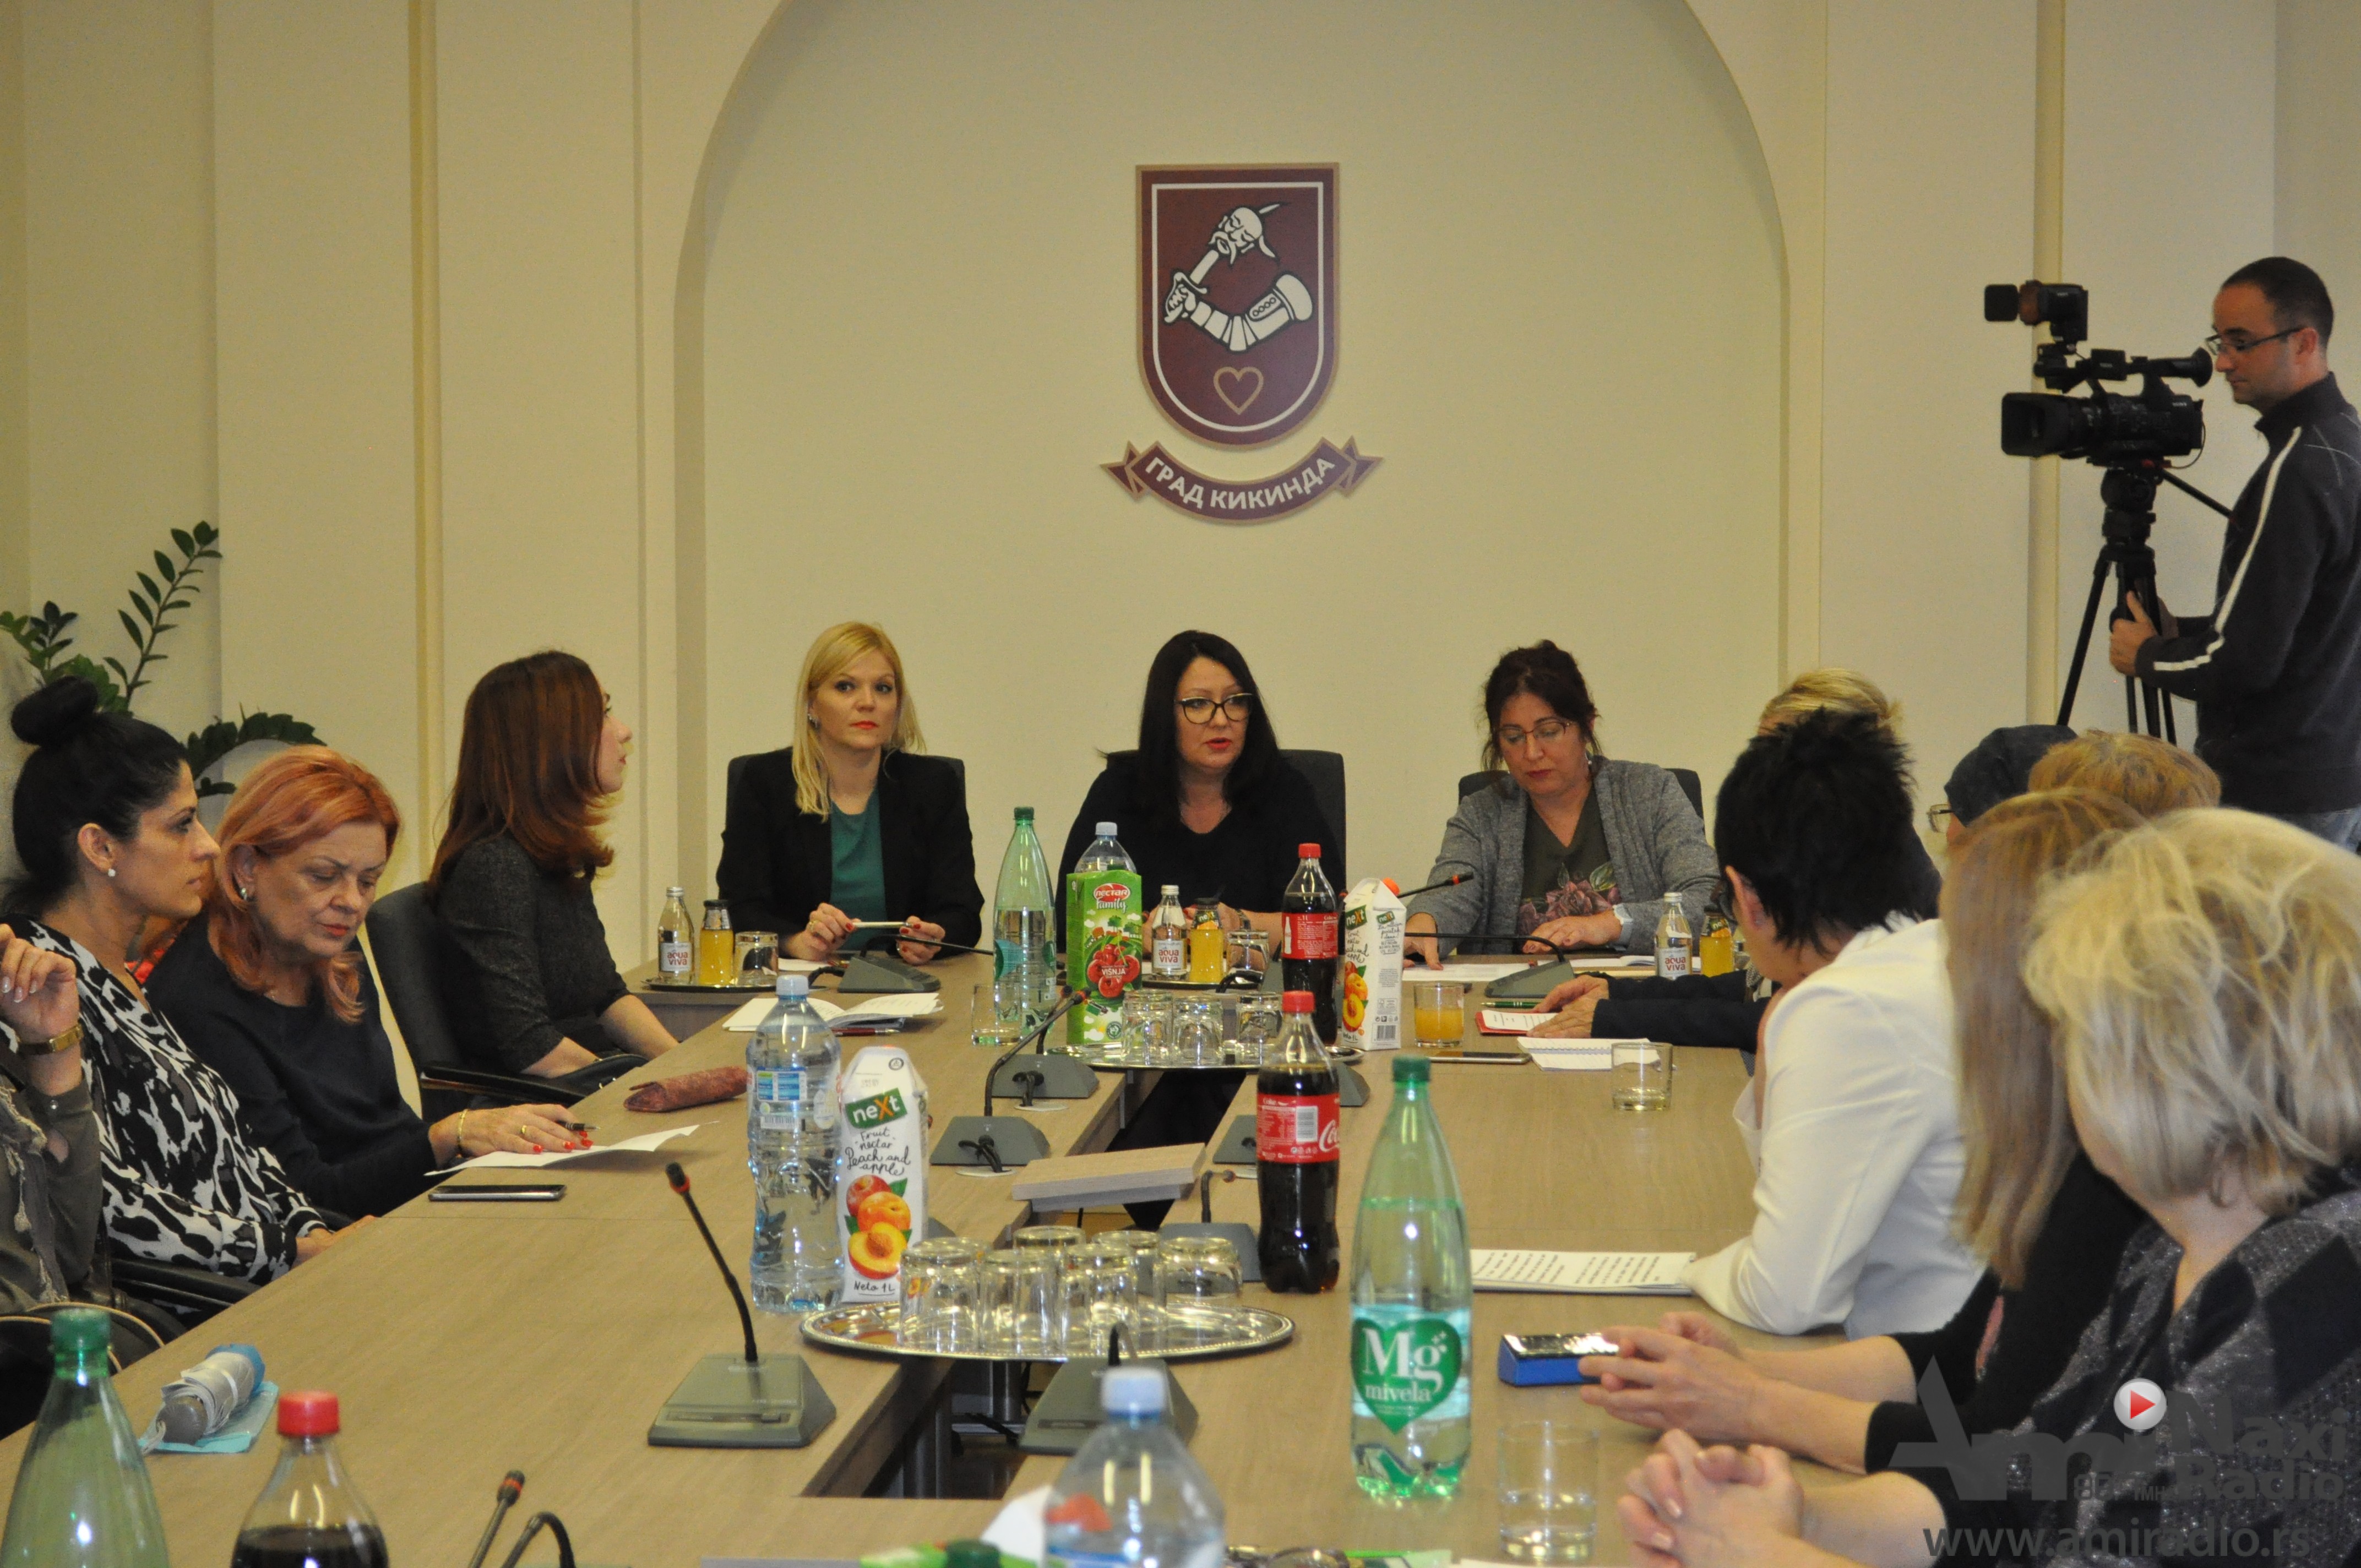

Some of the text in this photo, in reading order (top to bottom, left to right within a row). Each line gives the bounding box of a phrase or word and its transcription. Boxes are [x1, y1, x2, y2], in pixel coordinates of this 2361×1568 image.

[1145, 457, 1336, 510] ГРАД КИКИНДА
[860, 1126, 890, 1141] Fruit
[859, 1139, 893, 1150] nectar
[845, 1145, 911, 1170] Peach and
[859, 1162, 905, 1176] apple
[854, 1280, 879, 1291] Neto
[1362, 1327, 1447, 1394] Mg
[1365, 1381, 1433, 1402] mivela
